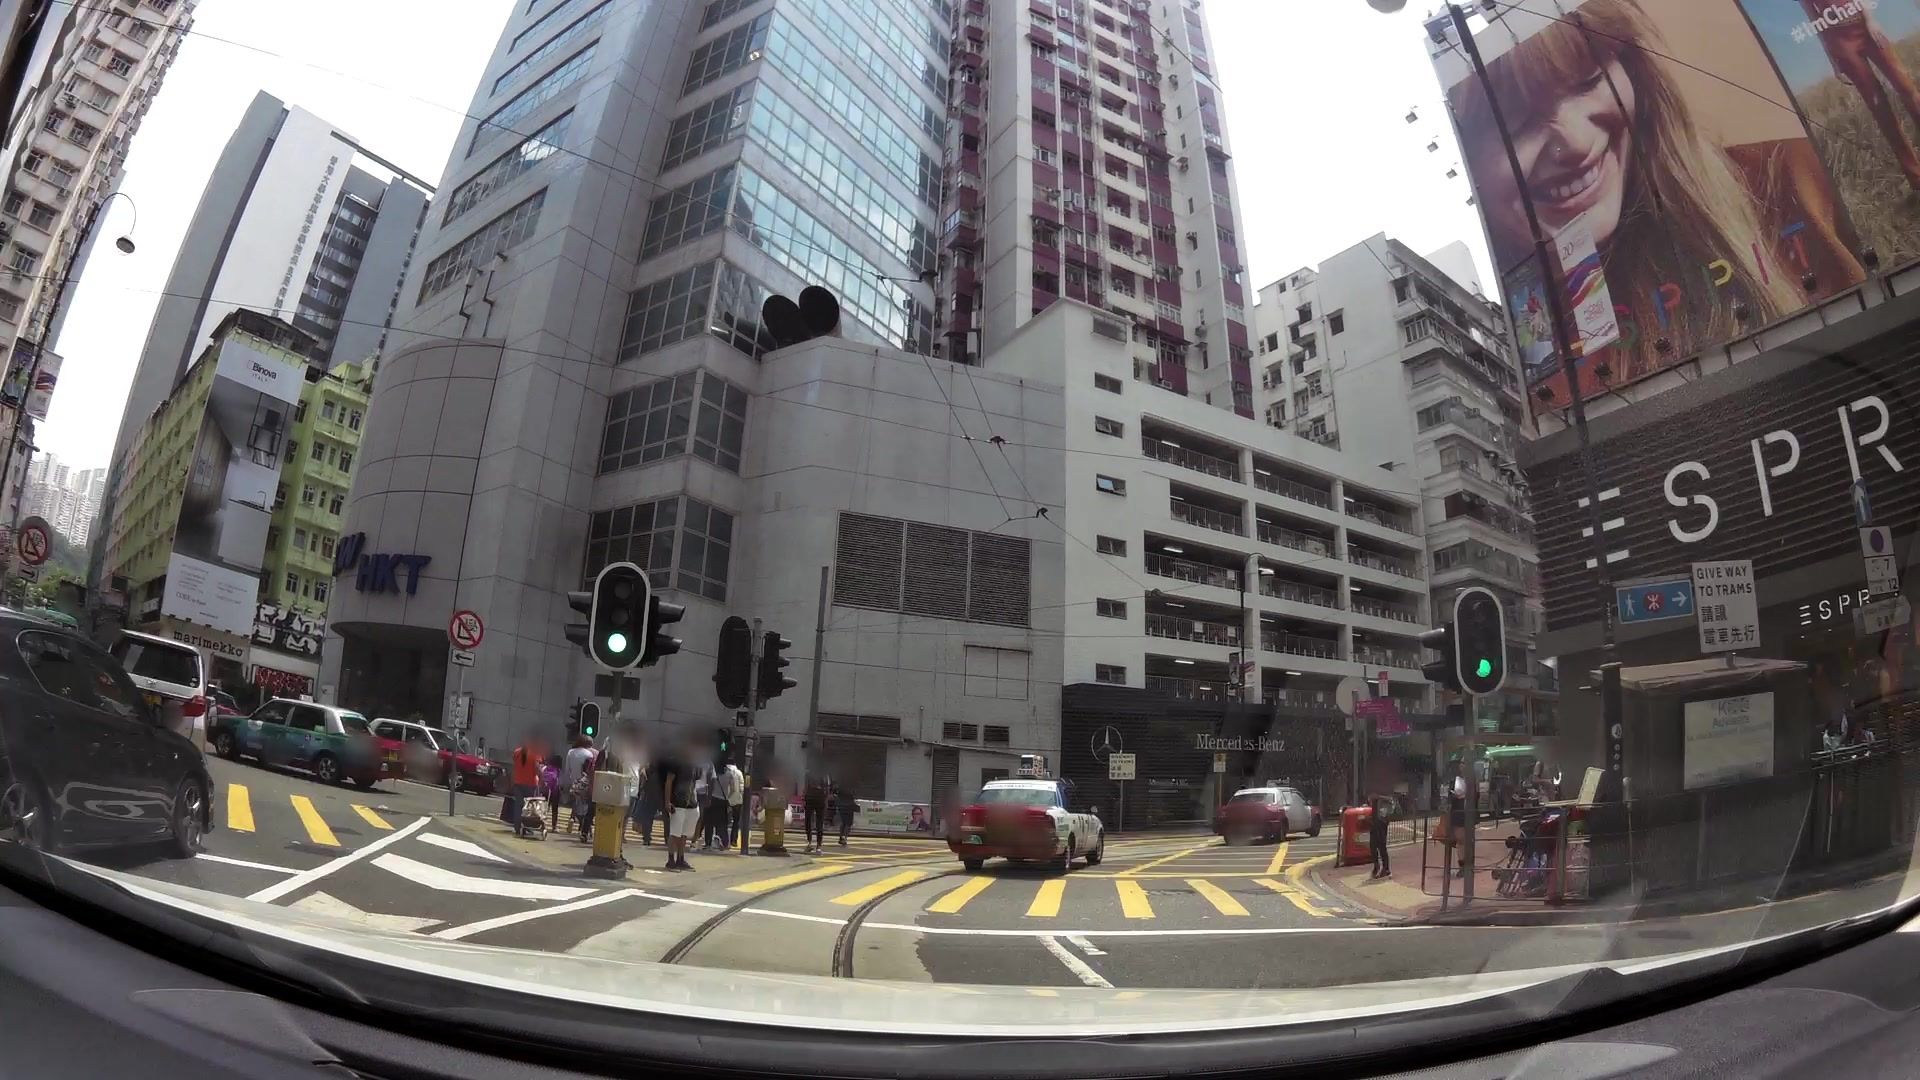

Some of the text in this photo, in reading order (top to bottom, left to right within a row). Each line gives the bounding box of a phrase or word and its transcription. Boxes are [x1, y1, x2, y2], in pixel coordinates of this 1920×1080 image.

[252, 362, 277, 380] Binova
[355, 553, 432, 596] HKT
[1696, 565, 1747, 580] GIVE WAY
[1699, 582, 1752, 597] TO TRAMS
[173, 630, 243, 657] marimekko
[1196, 733, 1285, 752] Mercedes-Benz
